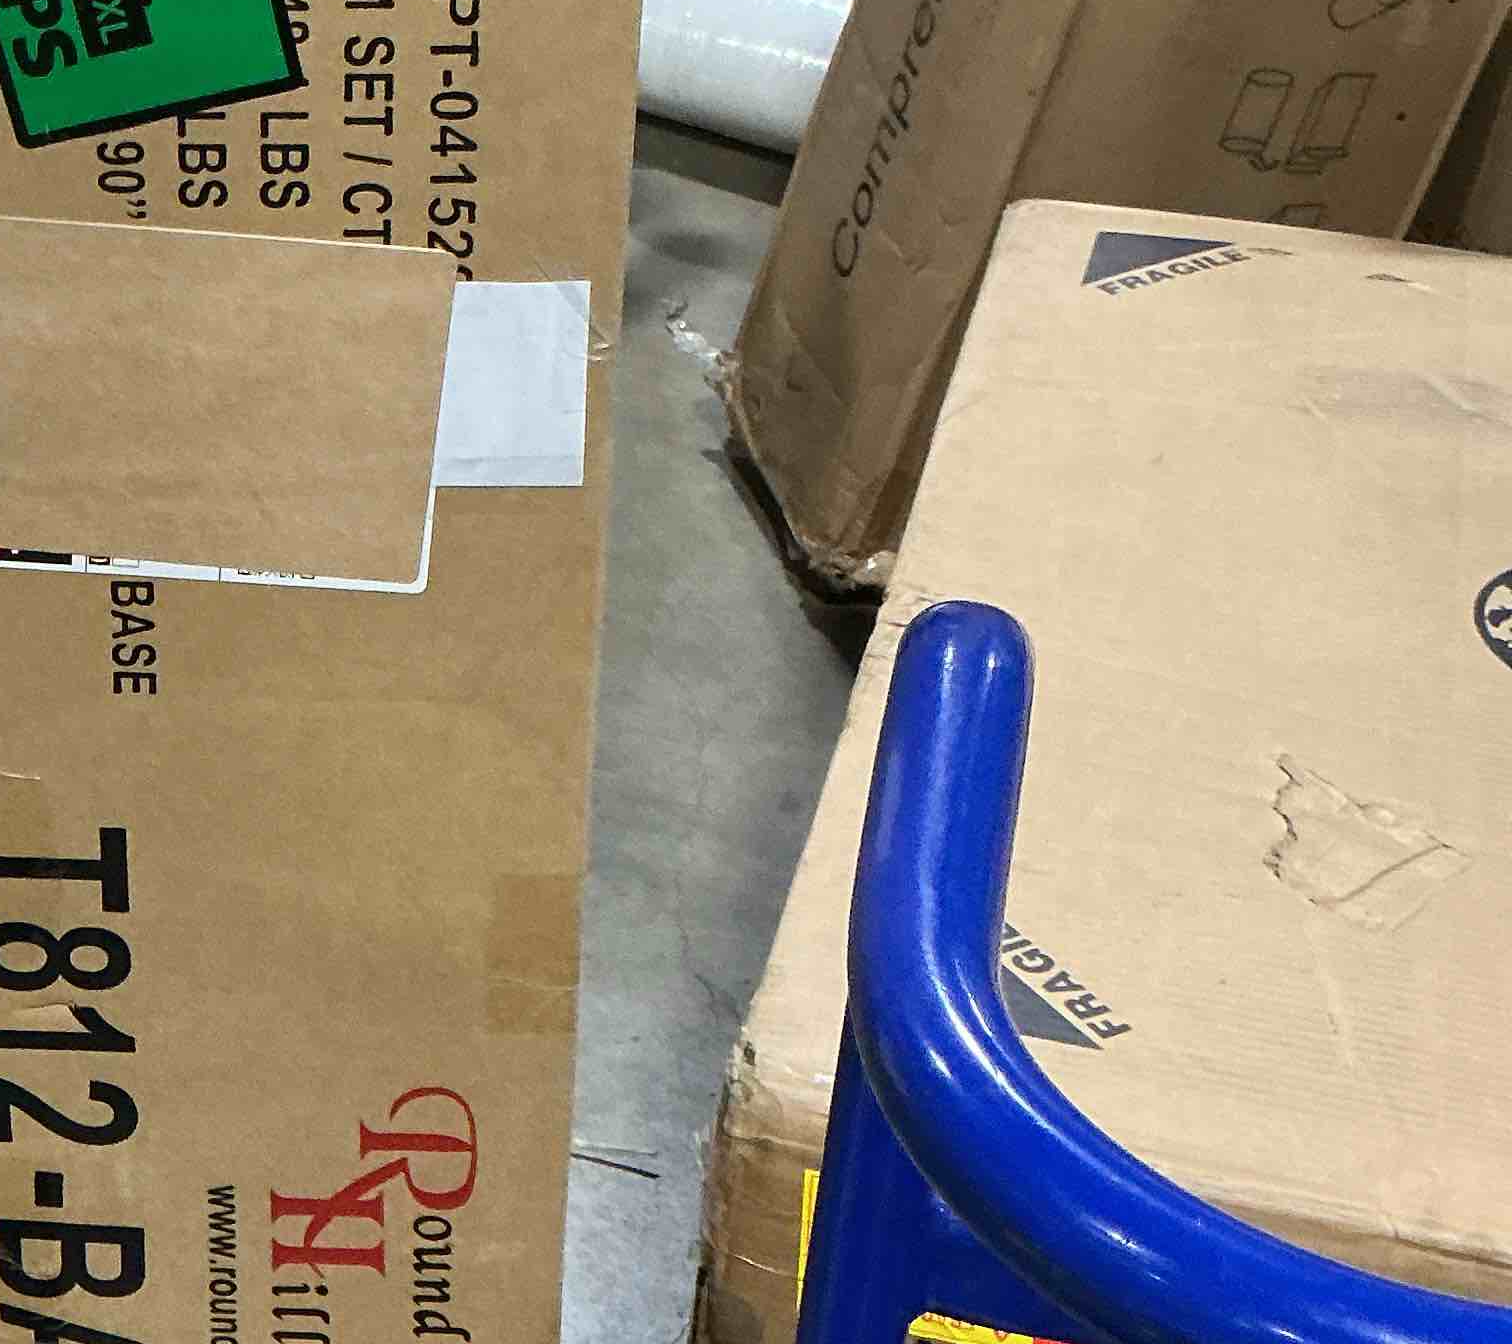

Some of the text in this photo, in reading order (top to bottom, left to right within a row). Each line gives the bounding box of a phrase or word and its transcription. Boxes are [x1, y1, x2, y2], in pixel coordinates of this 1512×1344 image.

[343, 36, 396, 136] SET
[176, 110, 229, 209] LBS
[259, 110, 310, 210] LBS
[1096, 247, 1252, 296] FRAGILE
[109, 579, 158, 696] BASE
[1000, 922, 1133, 1040] FRAGI
[358, 1086, 479, 1343] Round
